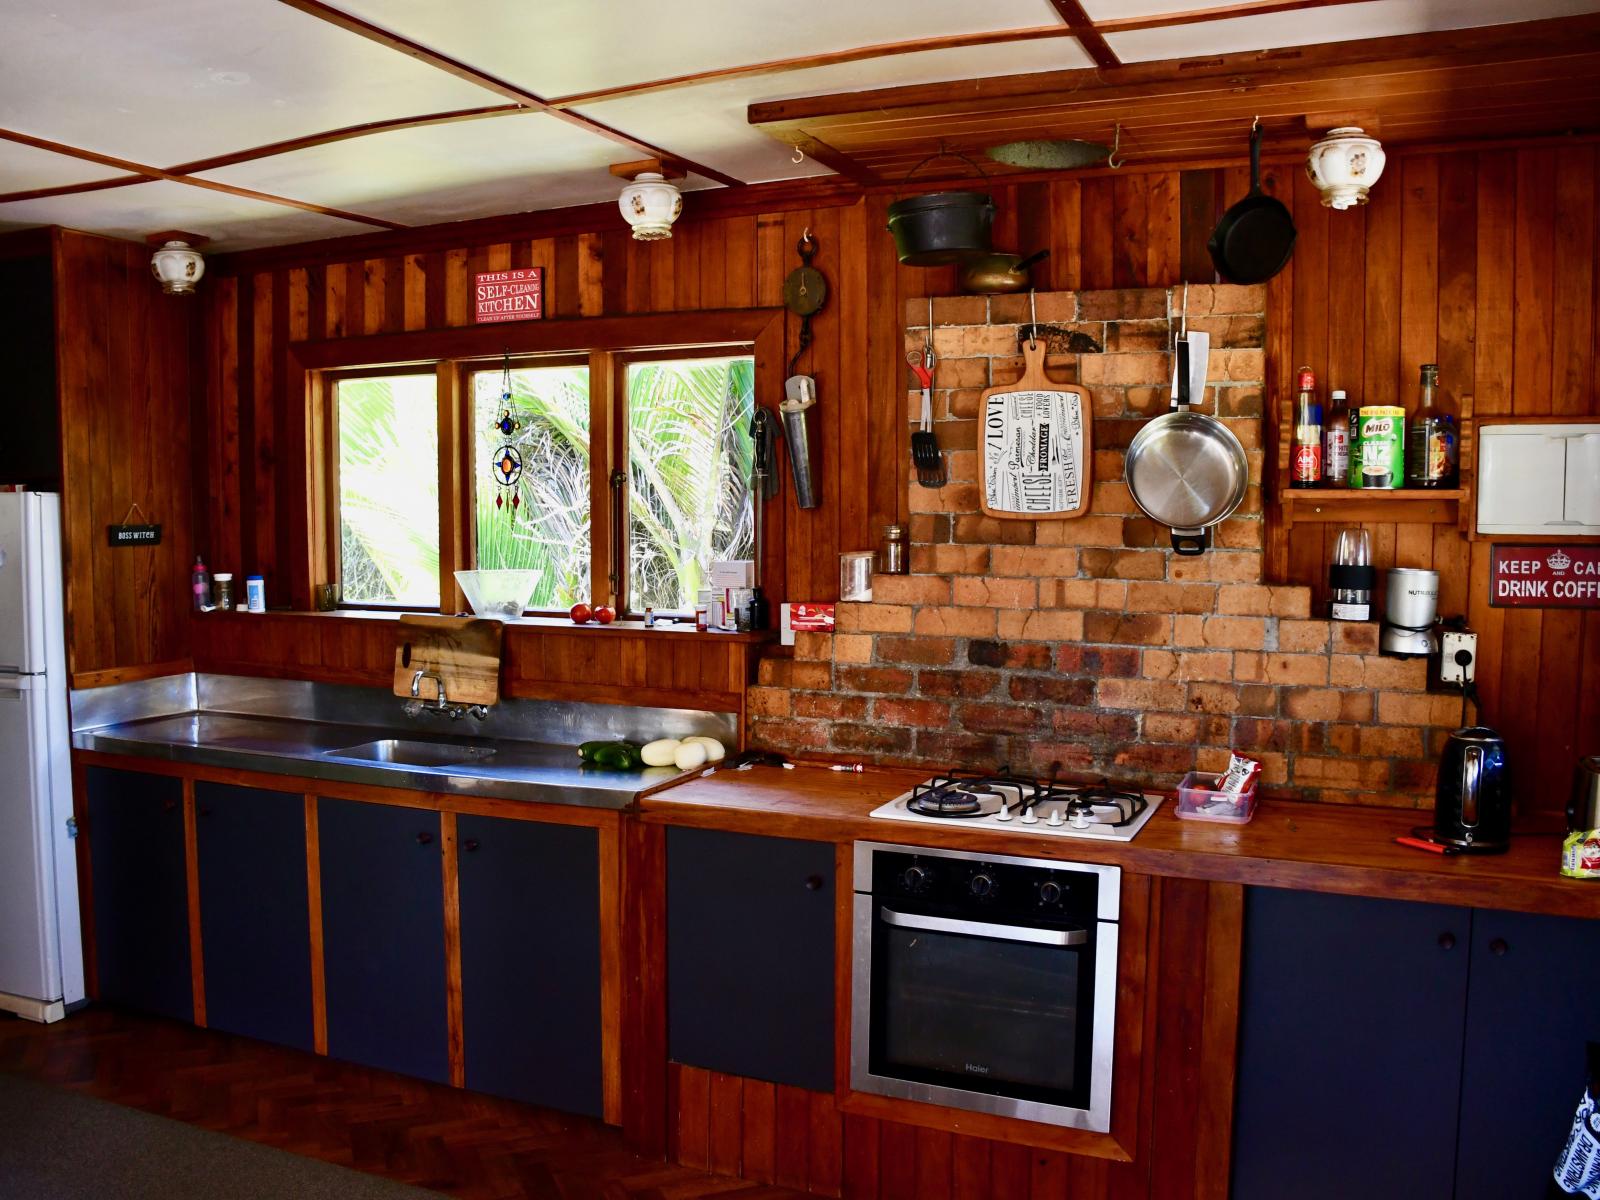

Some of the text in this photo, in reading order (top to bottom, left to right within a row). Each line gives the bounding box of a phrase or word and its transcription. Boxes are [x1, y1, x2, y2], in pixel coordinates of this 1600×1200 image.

[478, 273, 508, 281] THIS
[528, 270, 537, 278] A
[478, 284, 540, 300] SELF-CLEANING
[478, 293, 539, 313] KITCHEN
[1043, 394, 1051, 419] LOVERS
[987, 396, 1004, 439] LOVE
[1365, 423, 1390, 434] MILO
[1008, 427, 1021, 471] Parmesan
[1039, 426, 1049, 469] FROMAGE
[1022, 472, 1052, 511] CHEESE
[1063, 462, 1078, 504] FRESH
[133, 531, 155, 539] WITCH
[1499, 560, 1600, 575] KEEP CA
[1498, 580, 1600, 599] DRINK COFF
[965, 1063, 989, 1073] Haier
